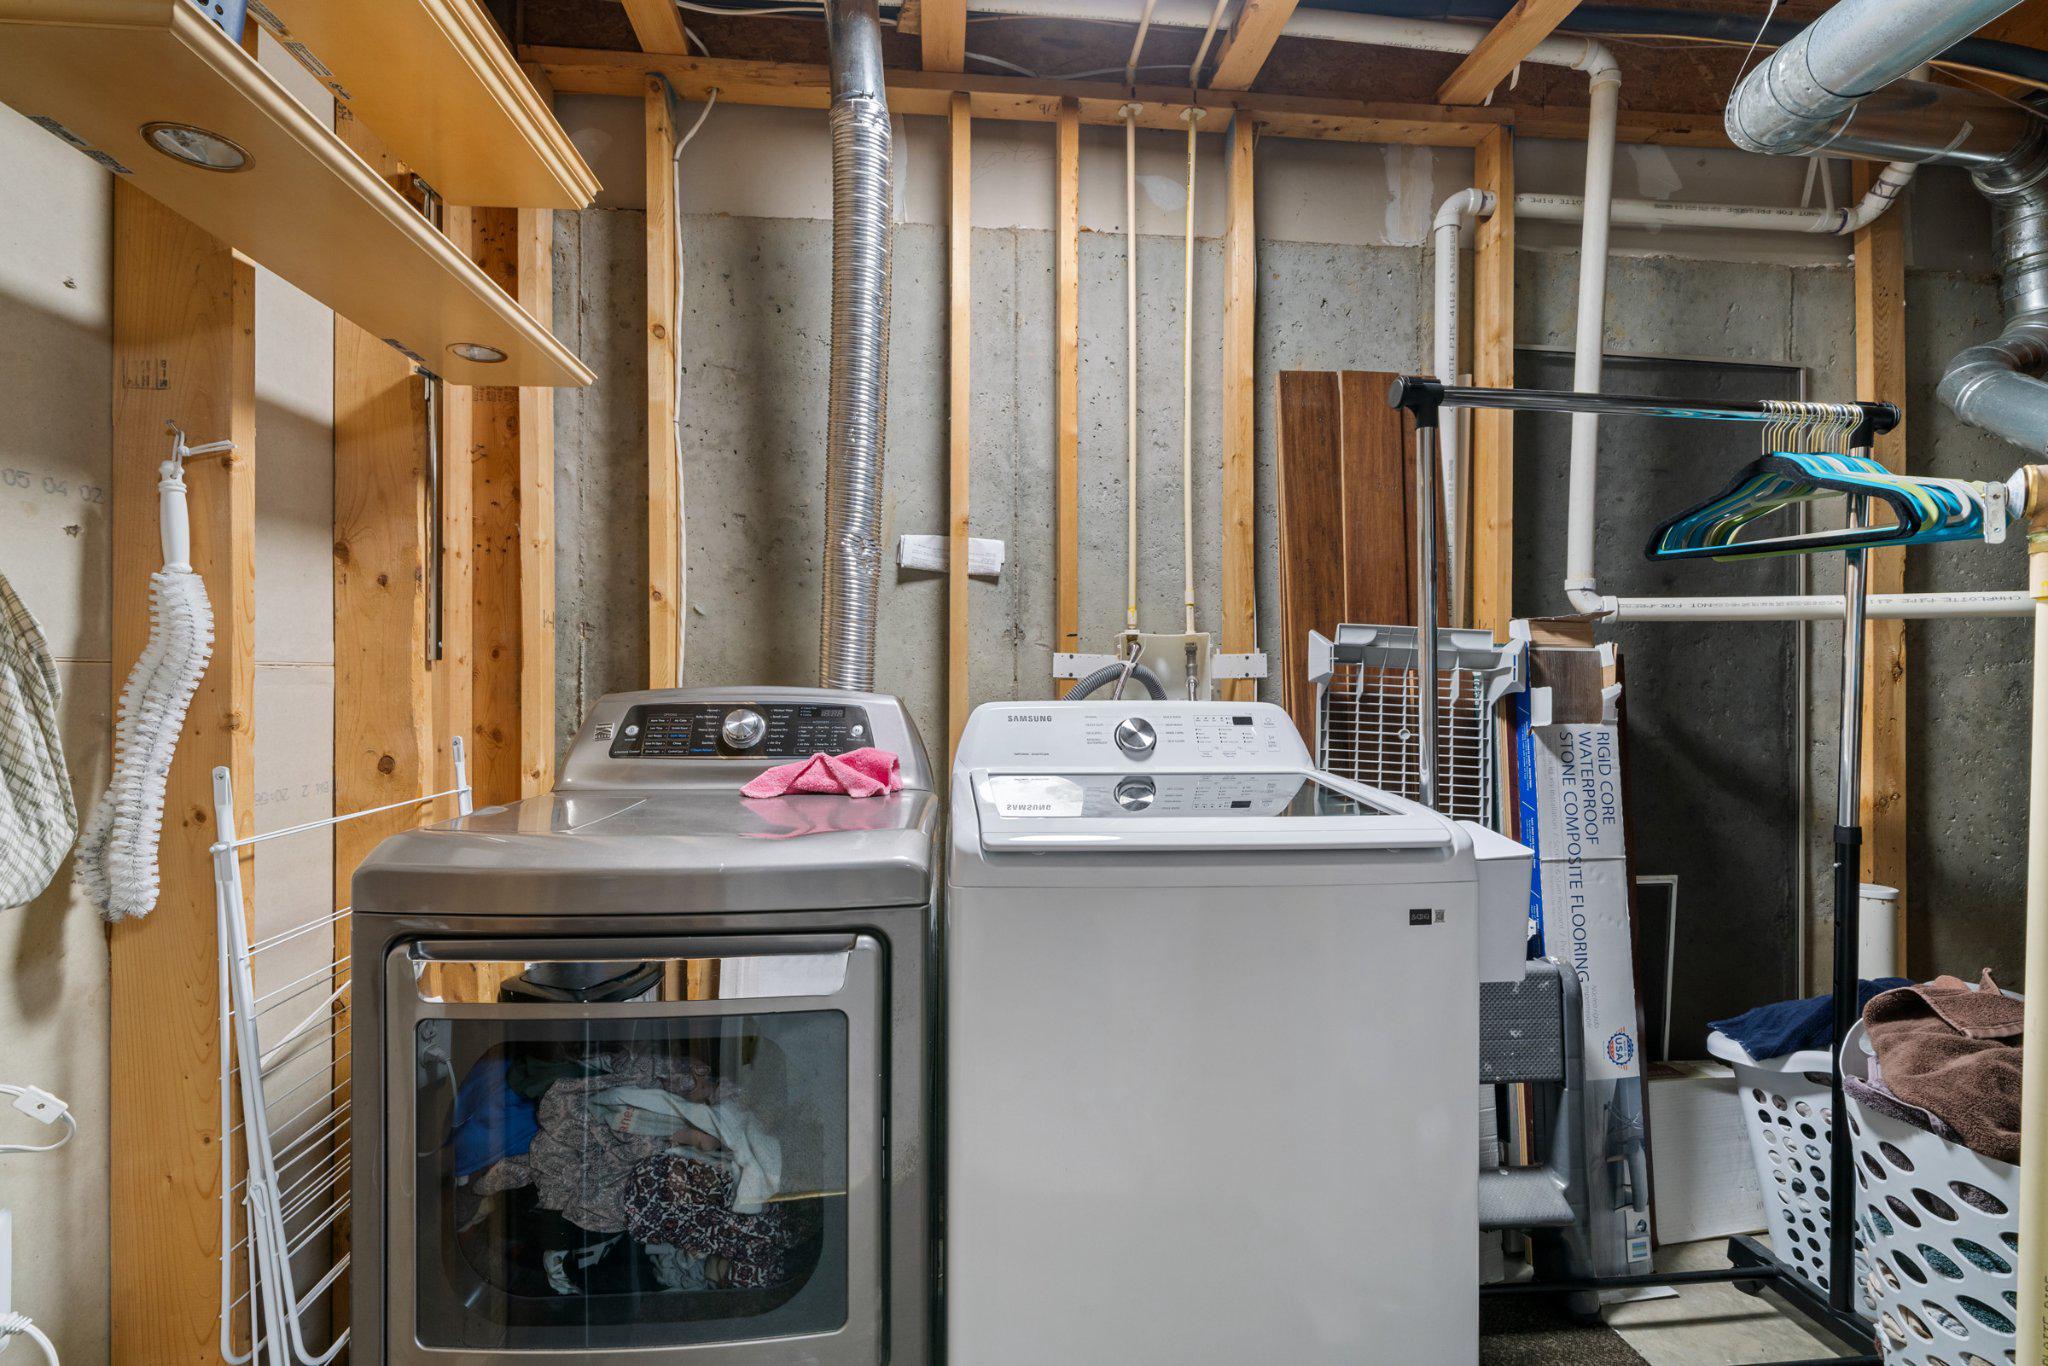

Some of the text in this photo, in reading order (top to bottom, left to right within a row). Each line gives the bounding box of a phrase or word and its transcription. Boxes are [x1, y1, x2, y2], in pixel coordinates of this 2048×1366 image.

[1, 467, 32, 489] 05
[1942, 595, 2021, 603] CHARLOTTE
[1578, 731, 1600, 845] WATERPROOF
[1596, 731, 1616, 826] RIGID CORE
[1560, 731, 1590, 984] STONE COMPOSITE FLOORING
[1615, 1037, 1624, 1061] USA
